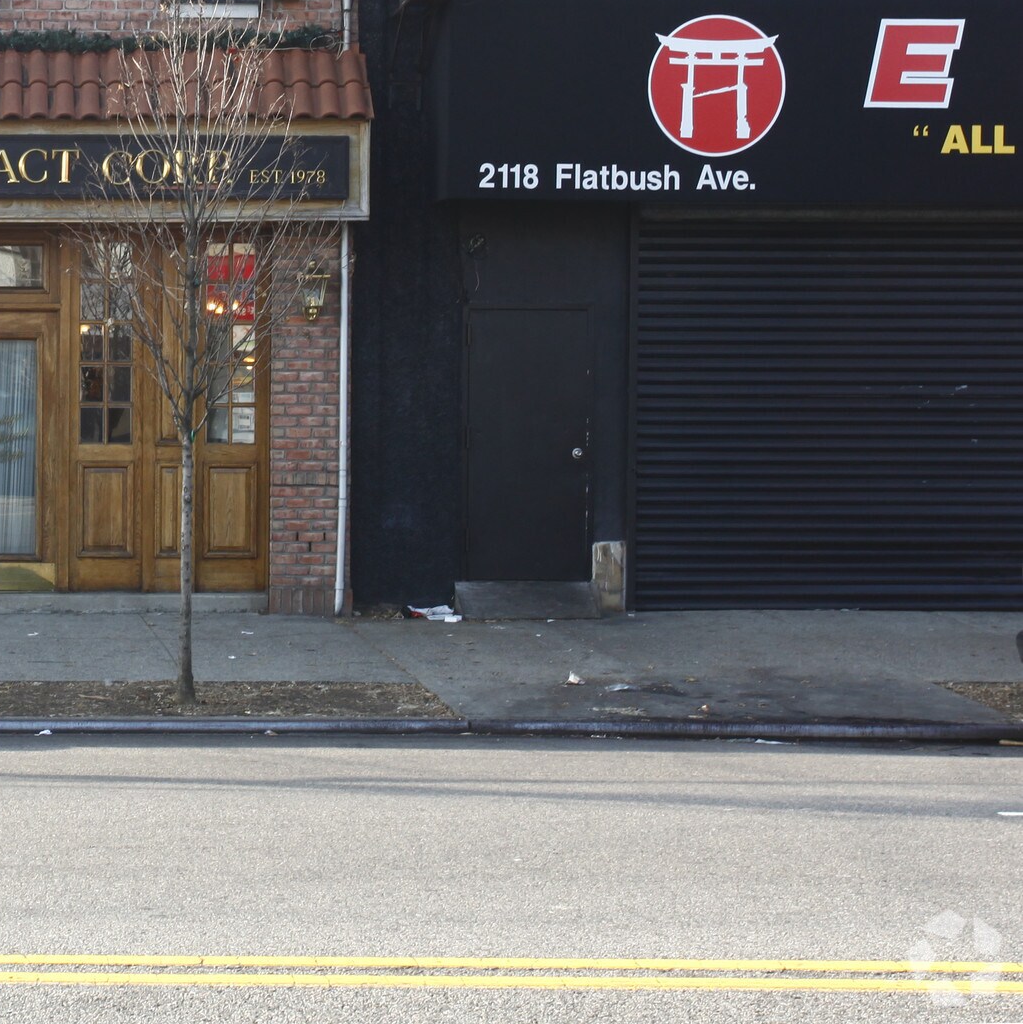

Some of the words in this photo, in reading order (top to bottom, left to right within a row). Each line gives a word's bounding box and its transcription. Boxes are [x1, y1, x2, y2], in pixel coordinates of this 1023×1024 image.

[863, 19, 966, 108] E
[940, 125, 1016, 154] ALL
[290, 169, 326, 184] 1978
[478, 163, 539, 189] 2118
[555, 163, 680, 191] Flatbush
[696, 164, 756, 190] Ave.
